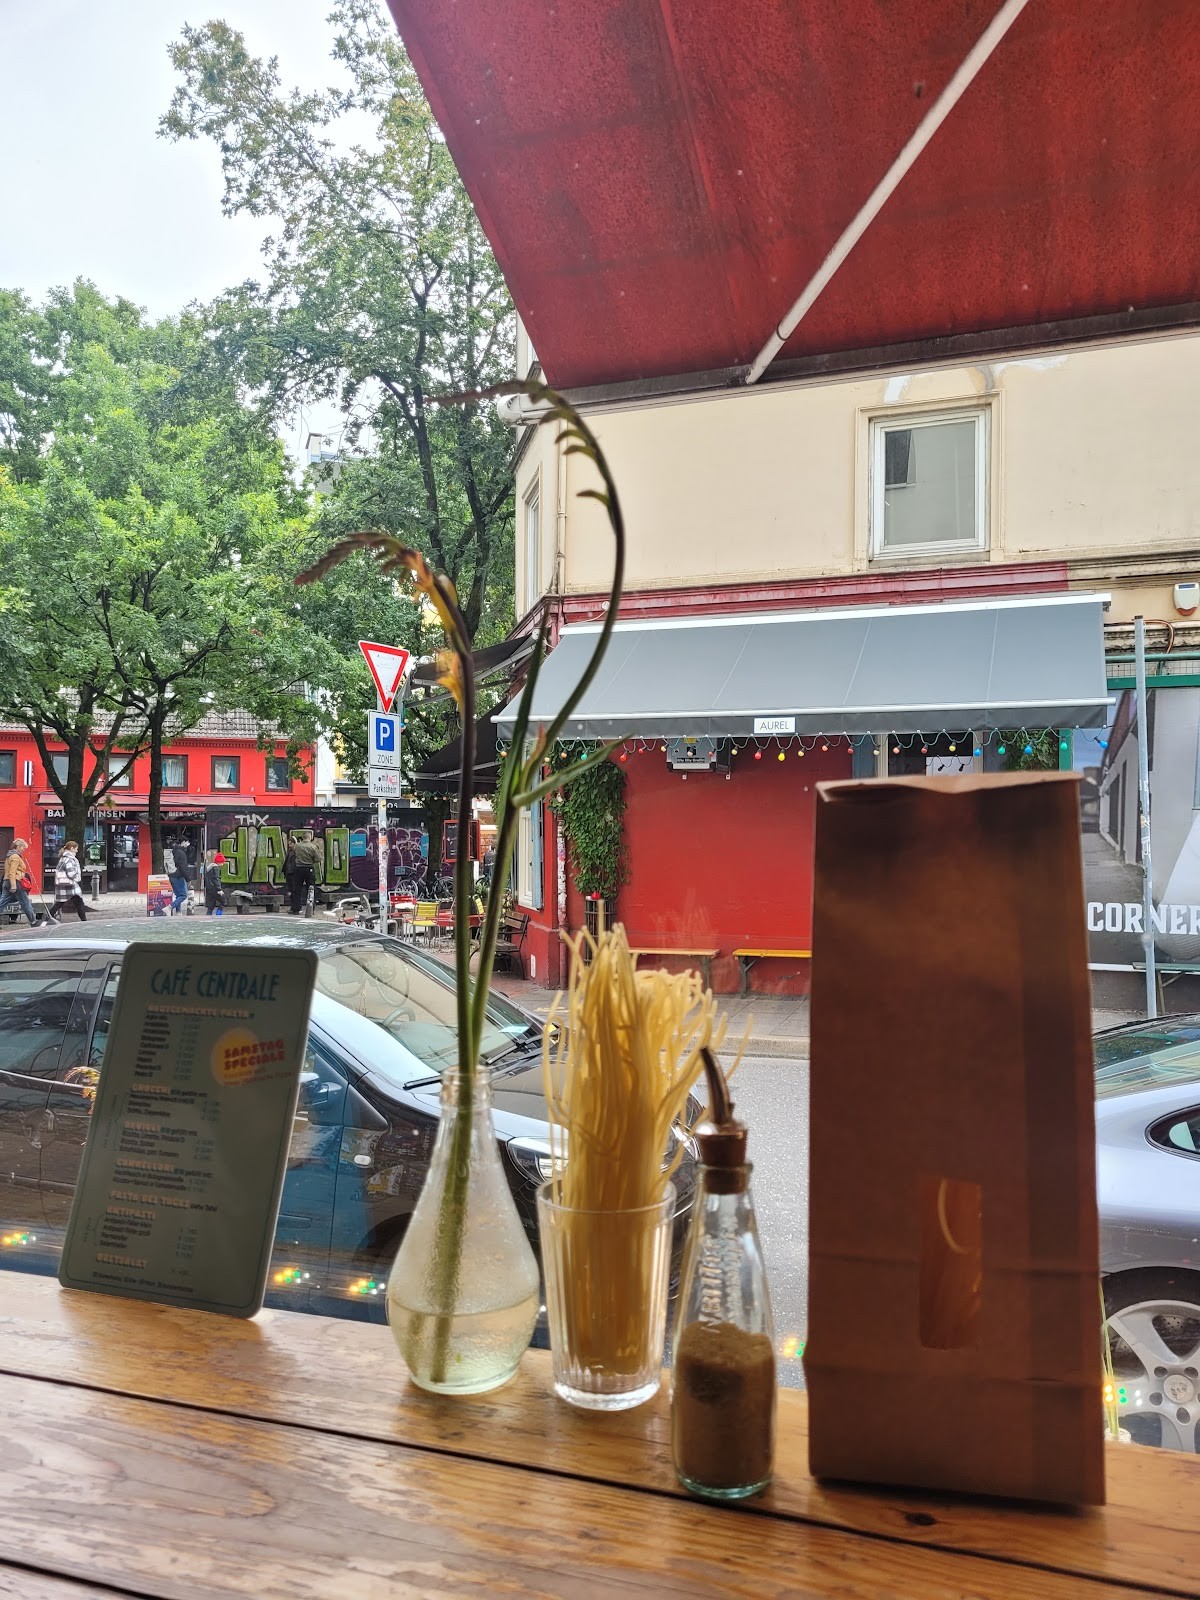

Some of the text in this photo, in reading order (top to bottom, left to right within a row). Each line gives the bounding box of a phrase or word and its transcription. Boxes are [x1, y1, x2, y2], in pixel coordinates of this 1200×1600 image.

[380, 723, 390, 746] P
[760, 721, 790, 730] AUREL
[378, 755, 393, 764] ZONE
[374, 784, 397, 794] Parkschein
[235, 814, 270, 826] THX
[1087, 902, 1200, 934] CORNER
[151, 965, 280, 1001] CAFÉ CENTRALE
[224, 1039, 284, 1058] SAMSTAG
[224, 1051, 285, 1070] SPECIALE
